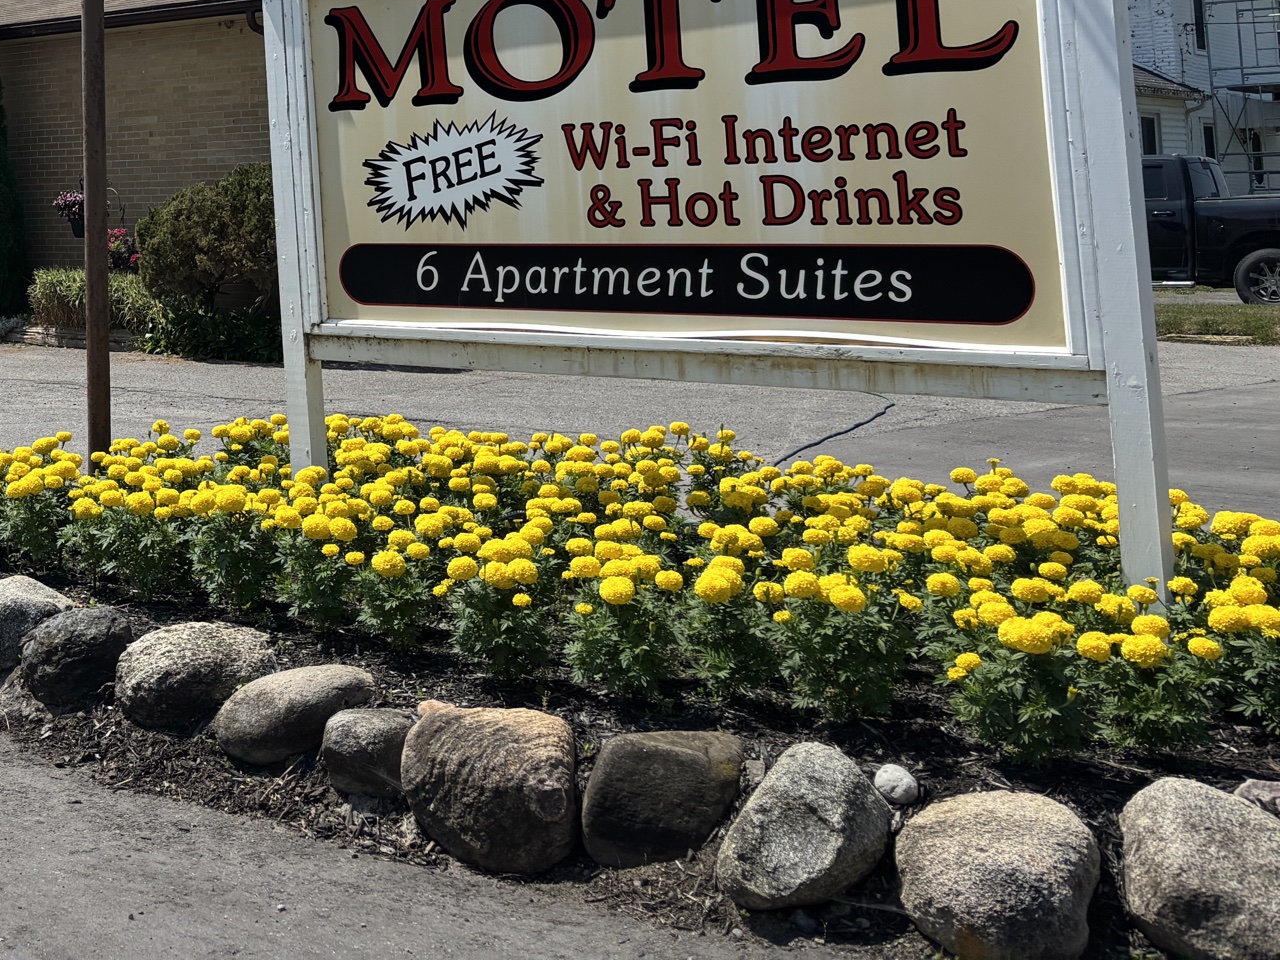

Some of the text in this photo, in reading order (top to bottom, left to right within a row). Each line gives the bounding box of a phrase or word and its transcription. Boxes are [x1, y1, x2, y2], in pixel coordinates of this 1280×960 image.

[561, 108, 968, 171] Wi-Fi Internet
[402, 139, 502, 202] FREE
[587, 170, 963, 228] & Hot Drinks
[416, 251, 914, 303] 6 Apartment Suites
